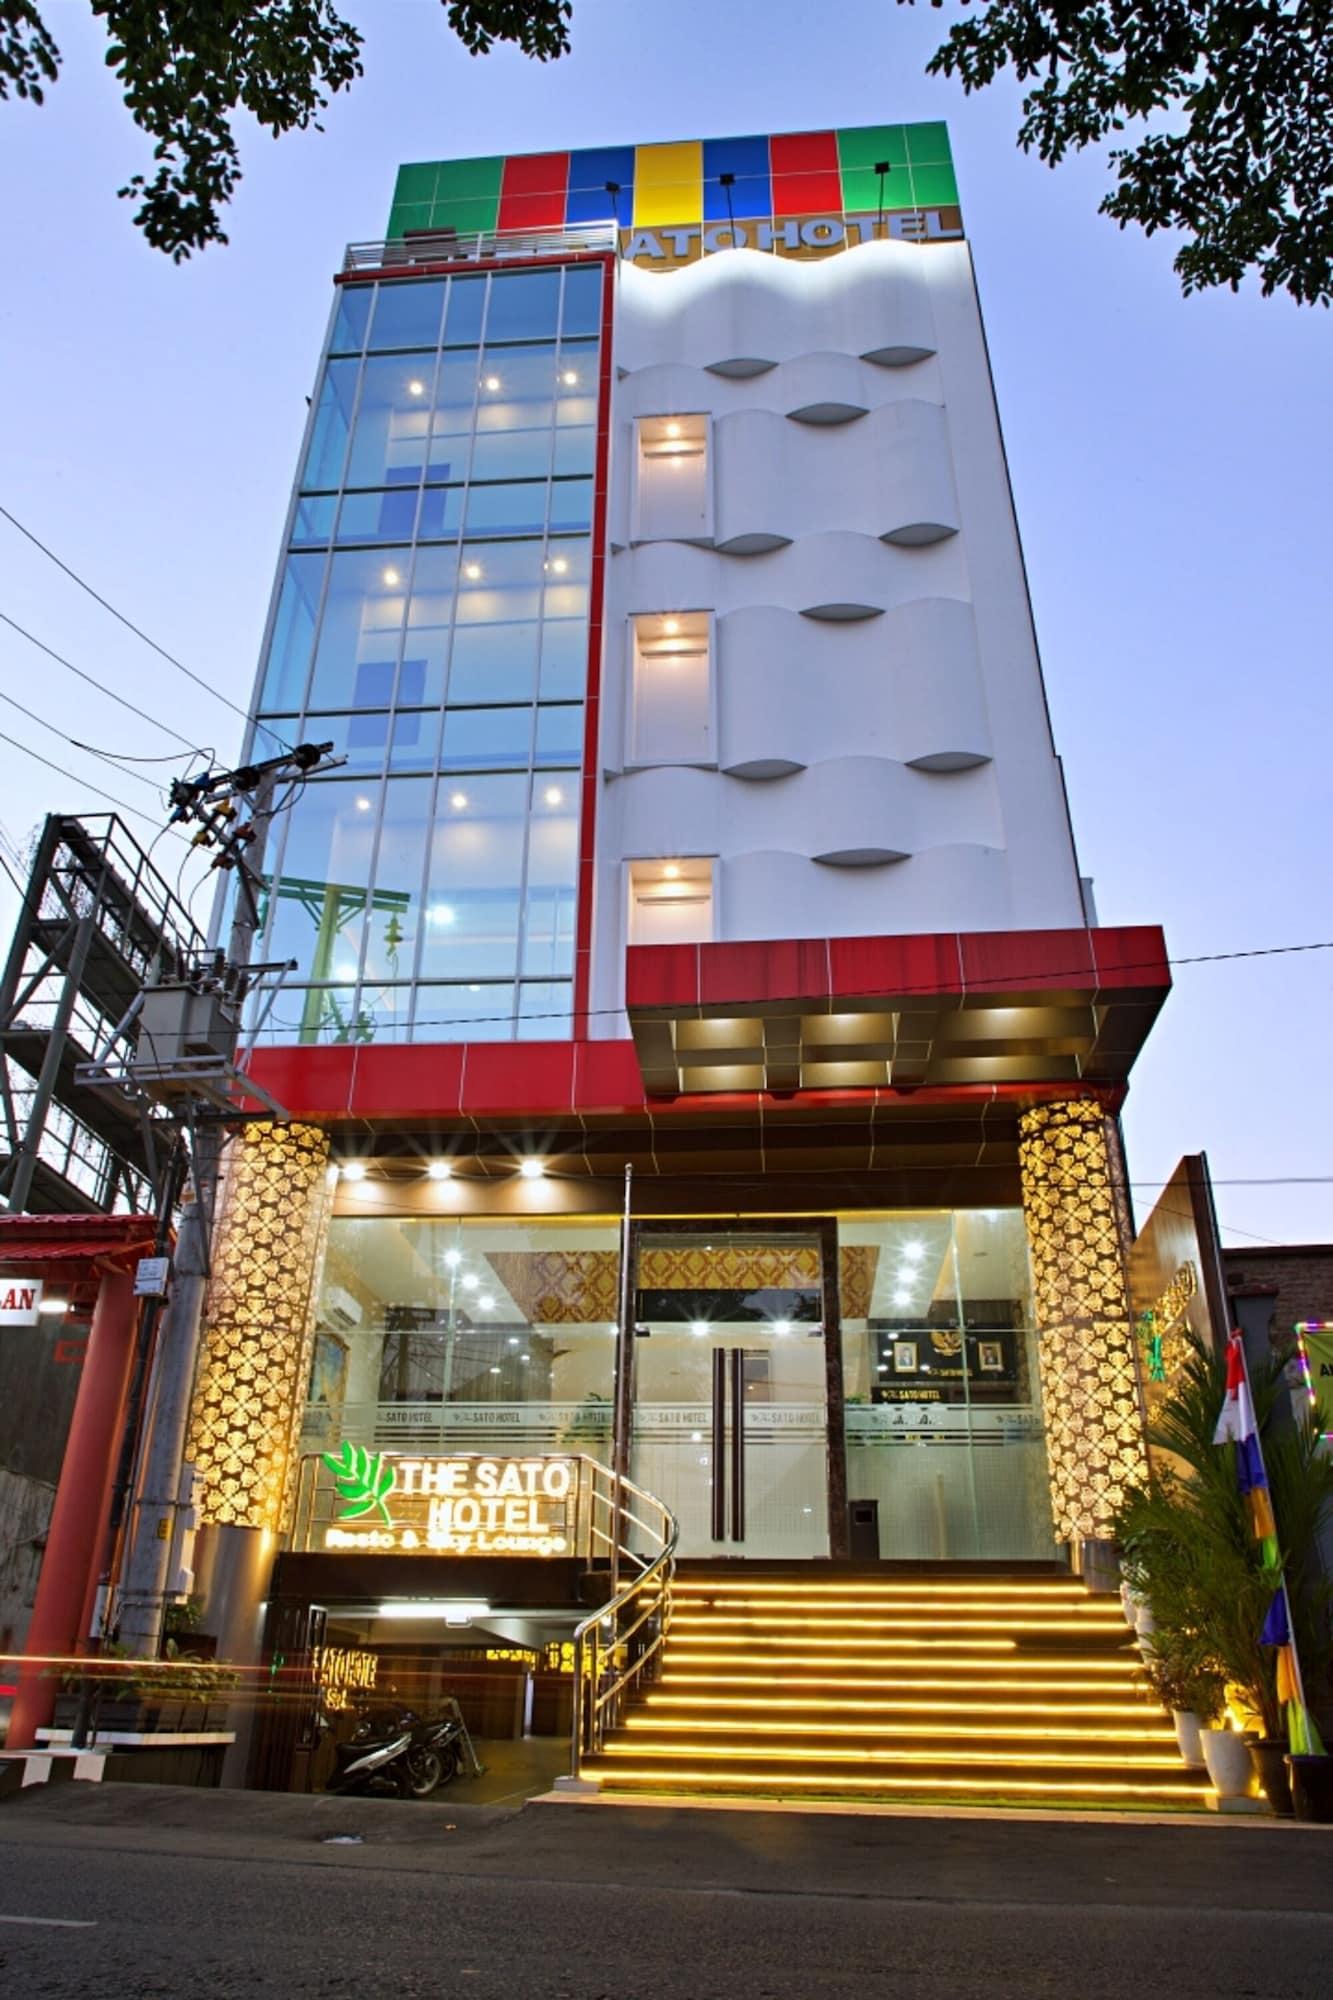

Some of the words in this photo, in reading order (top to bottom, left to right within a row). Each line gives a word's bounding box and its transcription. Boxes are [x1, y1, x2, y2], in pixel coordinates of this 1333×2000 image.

[624, 225, 747, 259] ATO
[758, 210, 965, 251] HOTEL
[0, 1288, 37, 1311] AN
[386, 1411, 407, 1423] SATO
[408, 1411, 433, 1423] HOTEL
[473, 1412, 494, 1423] SATO
[495, 1412, 521, 1423] HOTEL
[658, 1411, 681, 1423] SATO
[398, 1461, 469, 1495] THE
[474, 1462, 571, 1497] SATO
[428, 1497, 550, 1533] HOTEL
[477, 1531, 568, 1556] Lounge
